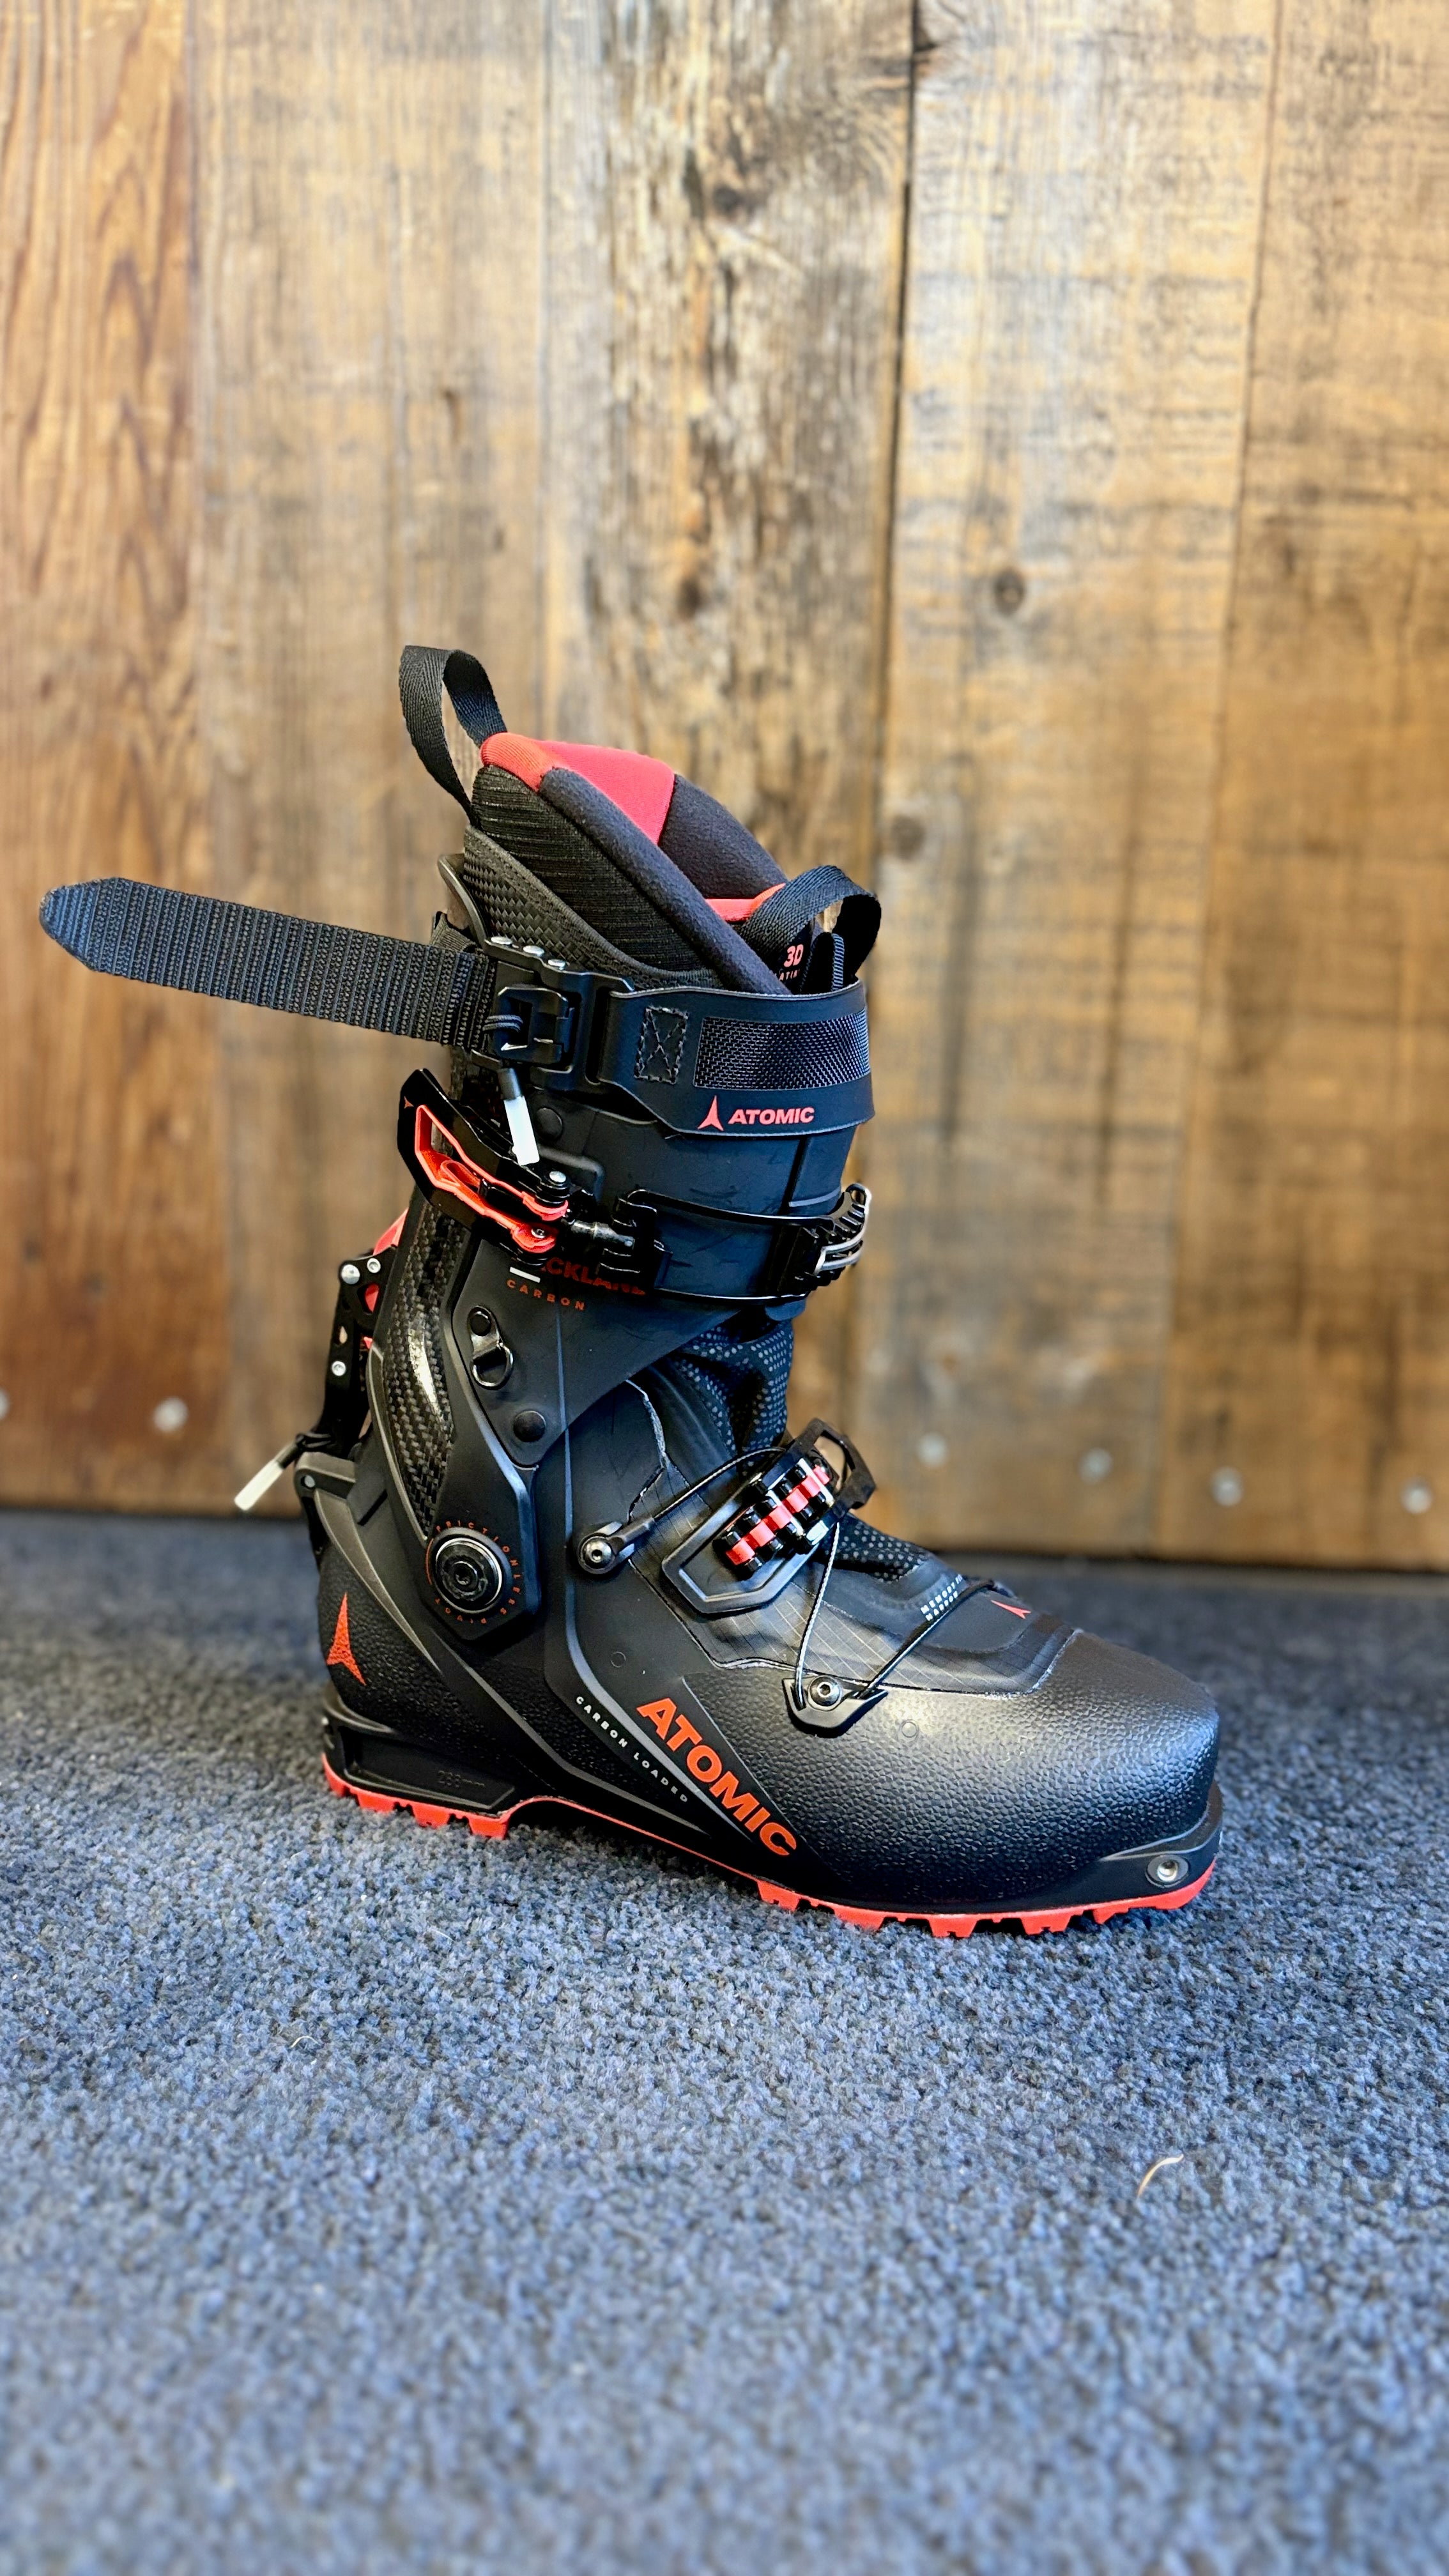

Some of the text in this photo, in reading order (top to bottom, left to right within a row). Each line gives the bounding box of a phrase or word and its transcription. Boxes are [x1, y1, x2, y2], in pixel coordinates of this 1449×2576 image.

[783, 944, 804, 968] 3D
[728, 1107, 815, 1125] ATOMIC
[506, 1278, 586, 1310] CARBON
[920, 1581, 955, 1614] MEMORY
[576, 1696, 688, 1802] CARBON LOADED
[636, 1697, 797, 1857] ATOMIC
